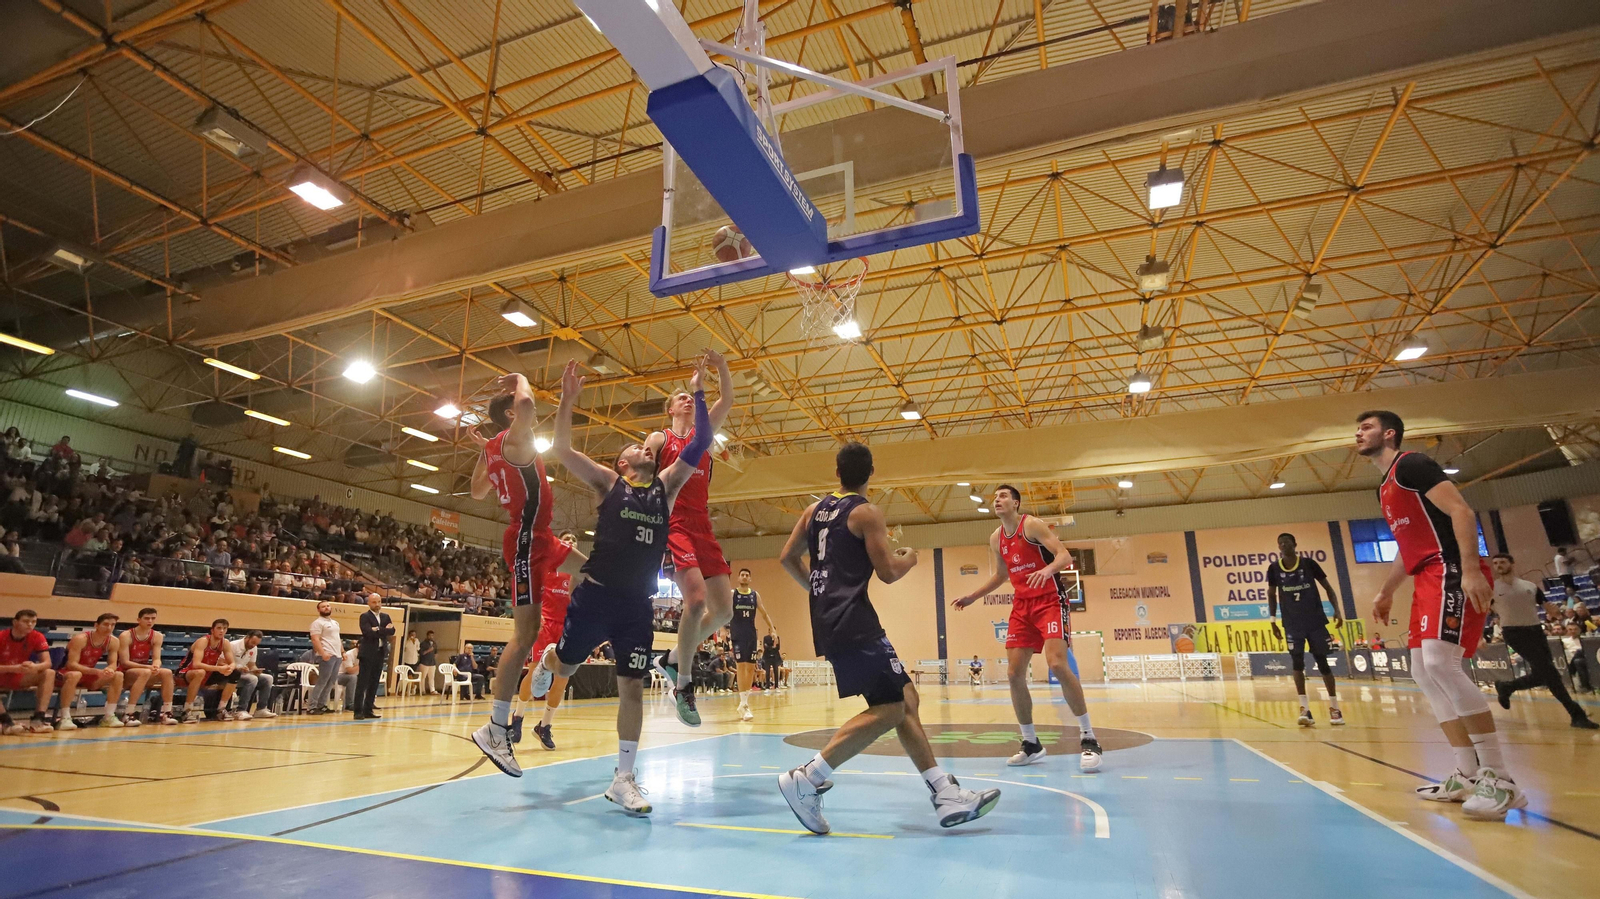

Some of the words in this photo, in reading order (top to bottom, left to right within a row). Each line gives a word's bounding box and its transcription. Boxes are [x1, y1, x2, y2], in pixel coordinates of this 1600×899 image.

[757, 125, 784, 173] SPORT
[784, 170, 815, 219] SYSTEM
[346, 488, 352, 499] C
[636, 526, 654, 544] 30
[1002, 546, 1009, 555] 16
[1141, 585, 1171, 598] MUNICIPAL
[1293, 592, 1301, 601] 7
[743, 610, 750, 618] 14
[1047, 621, 1058, 634] 16
[1421, 615, 1429, 632] 9
[1114, 628, 1142, 640] DEPORTES
[1204, 625, 1222, 653] LA
[628, 653, 647, 670] 30
[1477, 657, 1507, 670] damex.io
